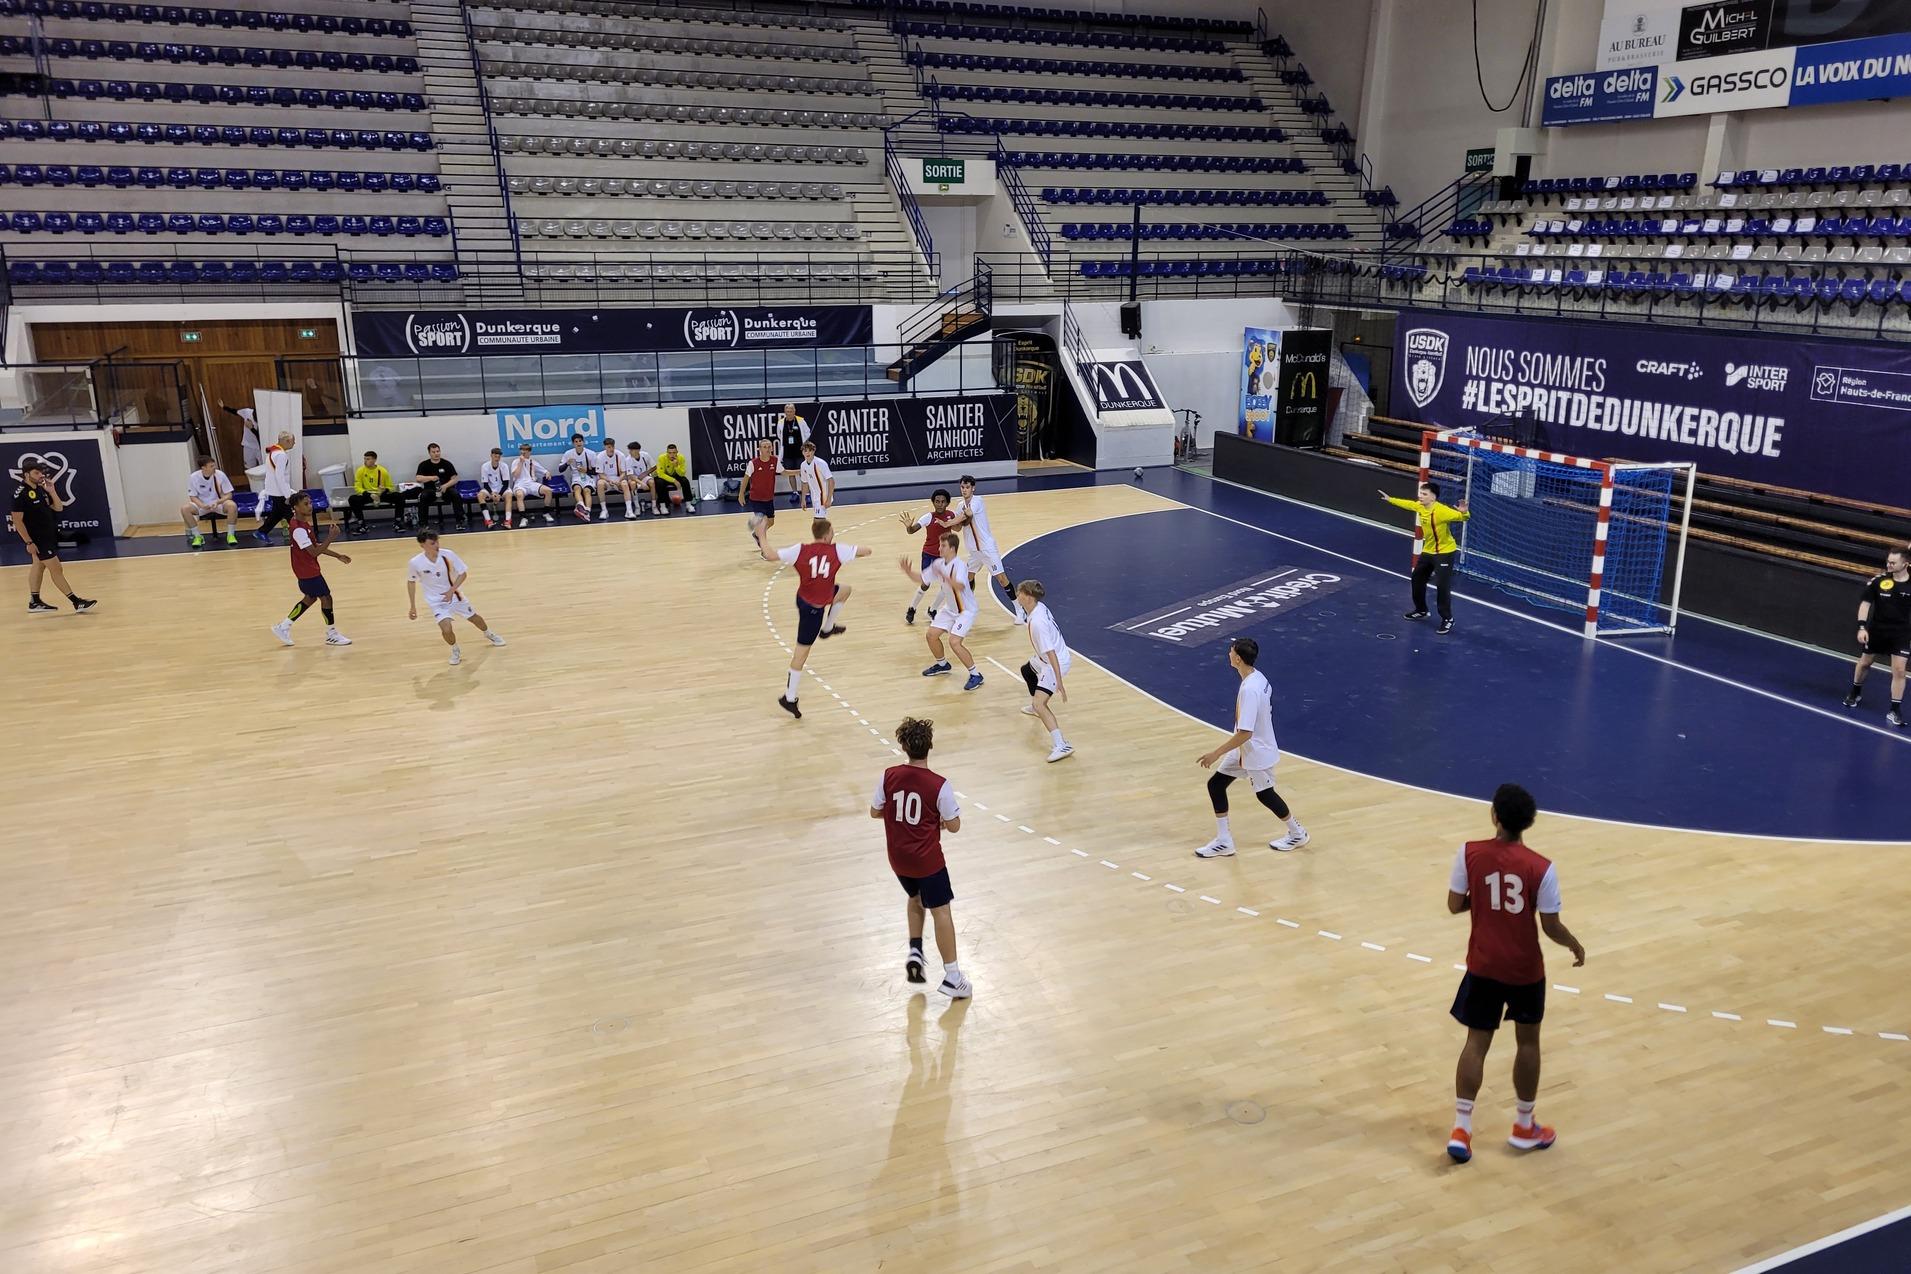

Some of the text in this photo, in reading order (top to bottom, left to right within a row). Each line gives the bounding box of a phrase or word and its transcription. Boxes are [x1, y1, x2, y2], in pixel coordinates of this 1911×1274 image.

[1609, 34, 1667, 53] AU BUREAU
[1795, 65, 1814, 86] LA
[1819, 60, 1861, 84] VOIX
[1862, 56, 1893, 79] DU
[1550, 76, 1595, 98] delta
[1603, 70, 1652, 93] delta
[1690, 67, 1787, 96] GASSCO
[1579, 97, 1593, 108] FM
[1635, 91, 1650, 102] FM
[925, 165, 963, 178] SORTIE
[476, 321, 560, 334] Dunkerque
[744, 318, 817, 330] Dunkerque
[418, 331, 462, 346] SPORT
[694, 327, 732, 341] SPORT
[1410, 335, 1444, 351] USDK
[1466, 346, 1607, 392] NOUS SOMMES
[1636, 360, 1688, 378] CRAFT
[1748, 365, 1788, 380] INTER
[1747, 377, 1786, 392] SPORT
[1842, 376, 1867, 386] Région
[1101, 400, 1157, 408] DUNKERQUE
[504, 410, 598, 440] Nord
[828, 408, 889, 434] SANTER
[926, 404, 984, 428] SANTER
[1462, 379, 1785, 458] #LESPRITDEDUNKERQUE
[828, 434, 888, 454] VANHOOF
[926, 428, 984, 449] VANHOOF
[830, 454, 890, 466] ARCHITECTES
[927, 448, 984, 460] ARCHITECTES
[809, 555, 831, 579] 14
[1150, 573, 1342, 642] Crédit Mutuel
[893, 790, 922, 826] 10
[1485, 871, 1525, 915] 13
